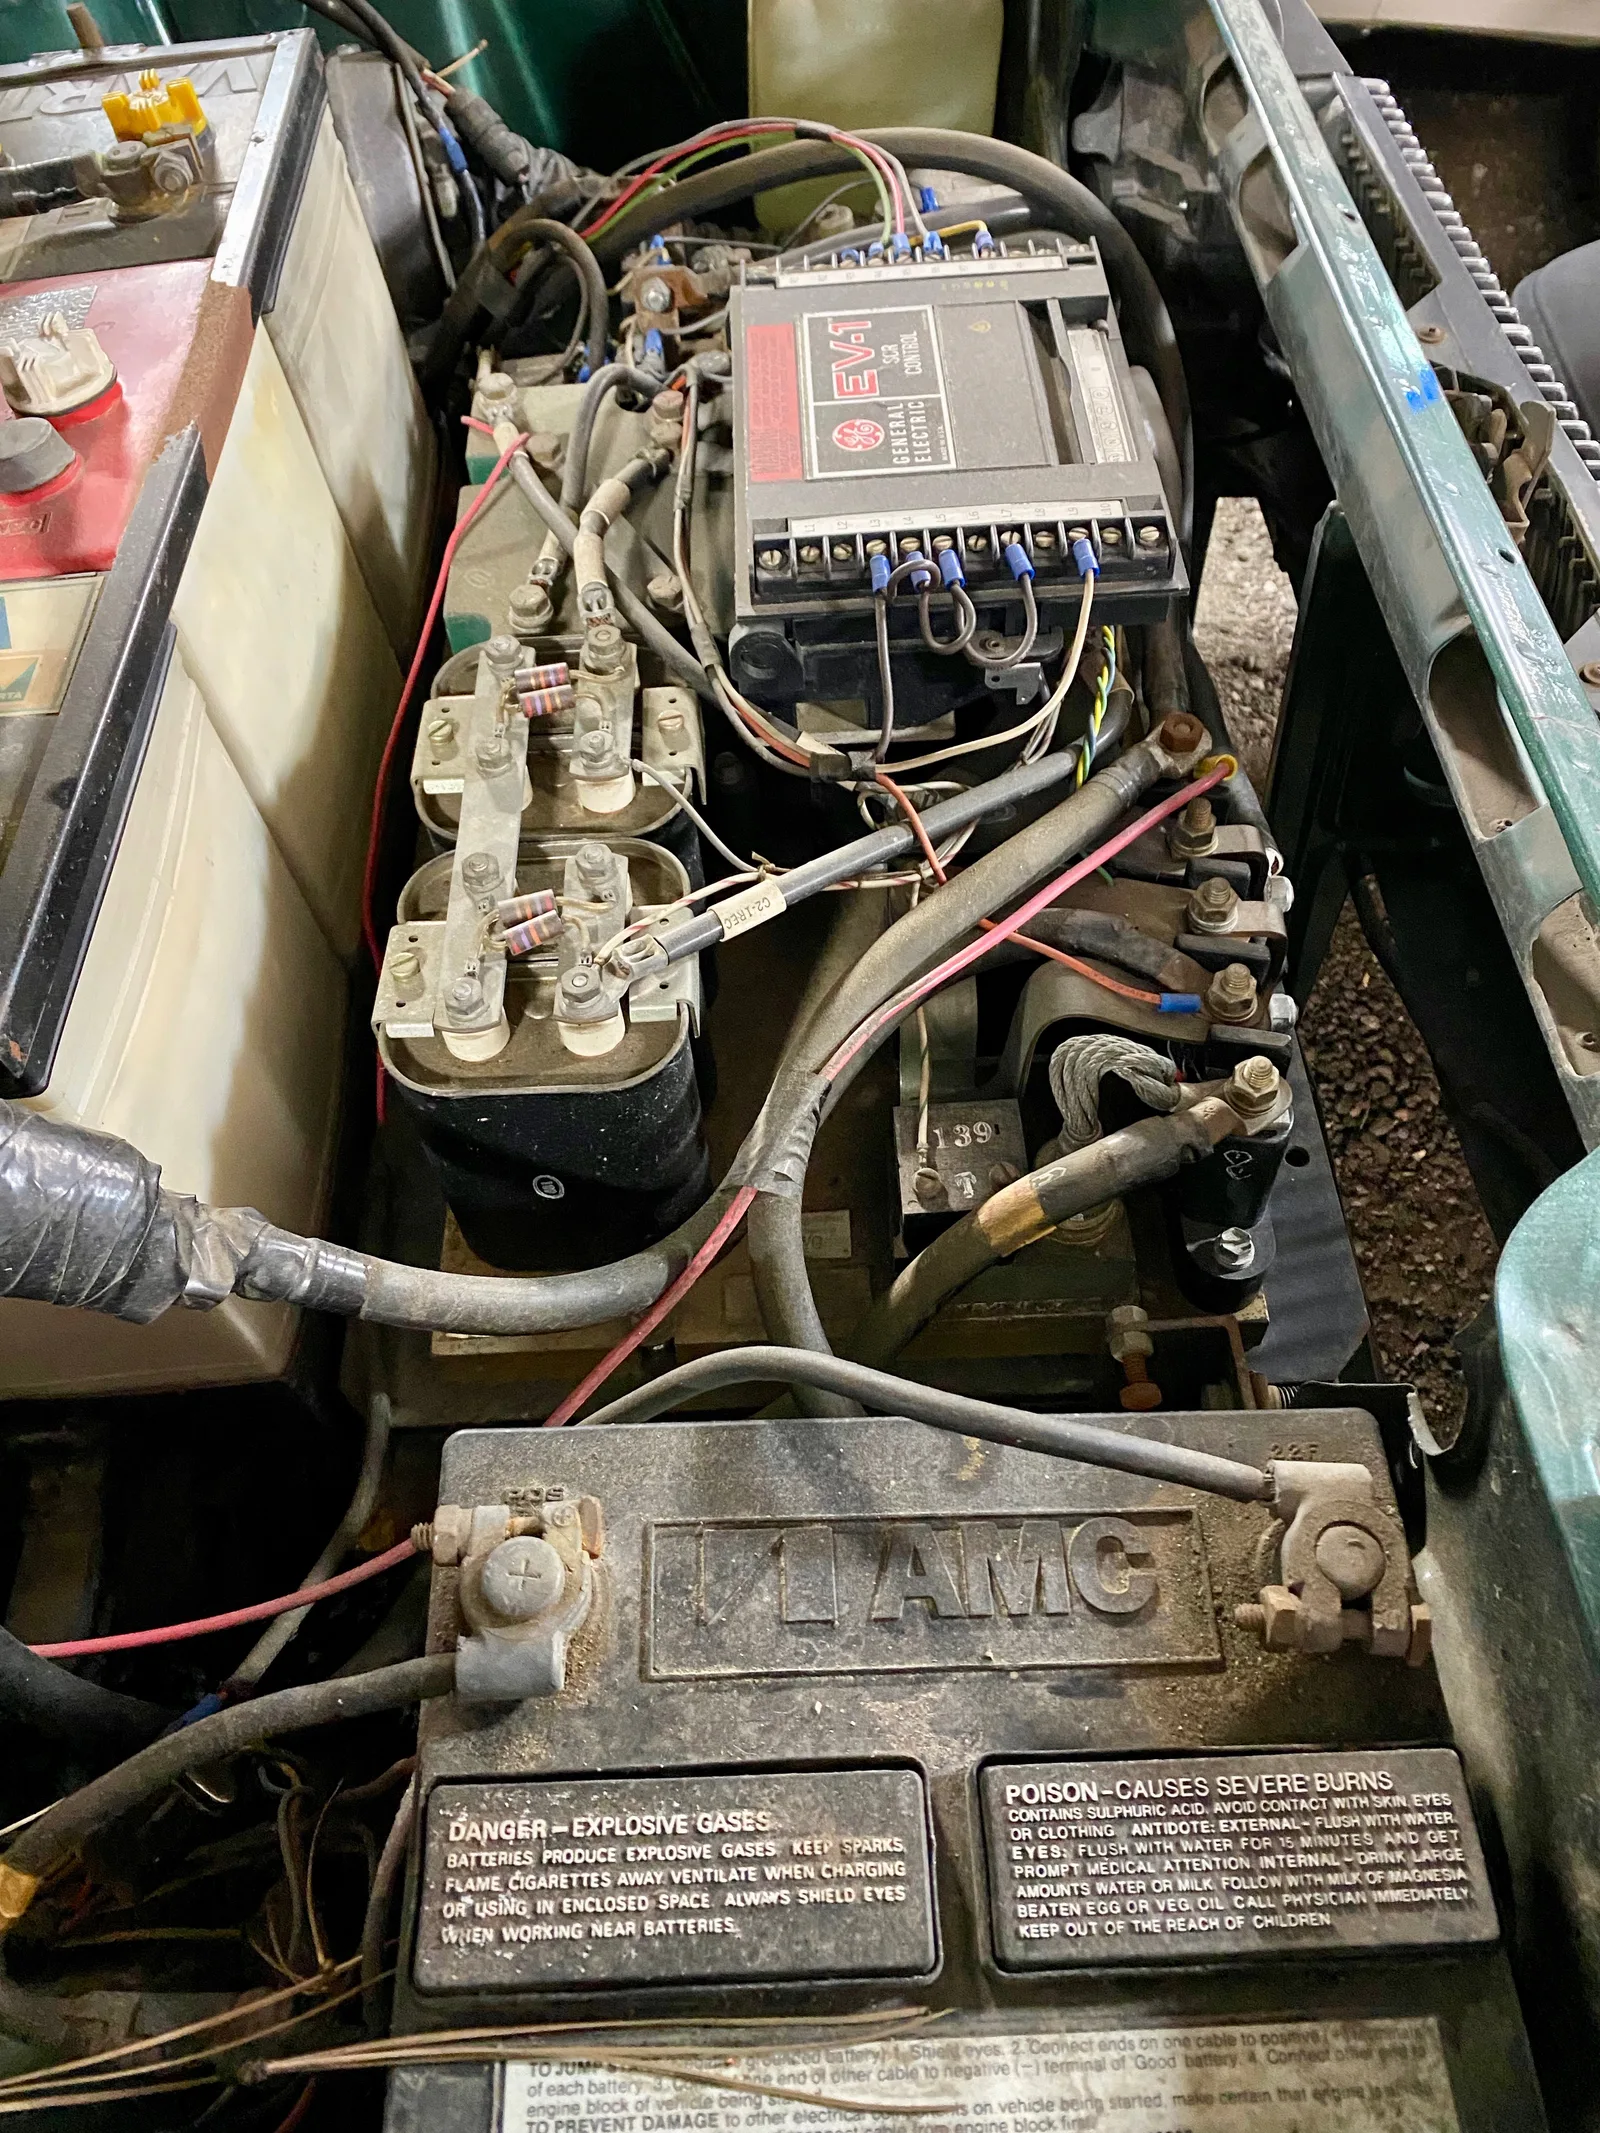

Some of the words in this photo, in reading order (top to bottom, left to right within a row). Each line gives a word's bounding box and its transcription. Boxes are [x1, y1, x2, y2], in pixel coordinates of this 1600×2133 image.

[881, 343, 900, 364] SCR
[901, 330, 922, 375] CONTROL
[887, 403, 910, 465] GENERAL
[908, 401, 932, 463] ELECTRIC
[804, 523, 815, 532] L1
[836, 520, 848, 530] L2
[870, 518, 881, 528] L3
[902, 516, 914, 525] L4
[936, 513, 947, 523] L5
[968, 510, 980, 520] L6
[1000, 508, 1012, 518] L7
[1034, 508, 1046, 517] L8
[1068, 506, 1078, 516] L9
[1100, 502, 1111, 516] L10
[725, 895, 771, 931] C2-1REC
[932, 1121, 993, 1149] 139
[871, 1516, 1160, 1622] AMC
[1217, 1774, 1308, 1795] SEVERE
[1315, 1771, 1394, 1792] BURNS
[1008, 1807, 1082, 1822] CONTAINS
[1087, 1804, 1166, 1819] SULPHURIC
[1214, 1800, 1256, 1814] AVOID
[1262, 1798, 1327, 1812] CONTACT
[1335, 1796, 1370, 1809] WITH
[1415, 1793, 1451, 1806] EYES
[696, 1811, 771, 1834] GASES
[1011, 1827, 1032, 1841] OR
[1132, 1820, 1215, 1836] ANTIDOTE:
[1315, 1814, 1360, 1829] FLUSH
[1365, 1814, 1400, 1827] WITH
[447, 1851, 533, 1868] BATTERIES
[542, 1848, 616, 1864] PRODUCE
[626, 1845, 711, 1861] EXPLOSIVE
[792, 1840, 833, 1855] KEEP
[1012, 1845, 1067, 1860] EYES:
[1079, 1843, 1128, 1857] FLUSH
[1135, 1841, 1172, 1854] WITH
[1181, 1839, 1233, 1852] WATER
[1241, 1838, 1272, 1850] FOR
[1279, 1837, 1293, 1848] 15
[1301, 1832, 1373, 1847] MINUTES
[1384, 1832, 1418, 1845] AND
[1428, 1830, 1461, 1844] GET
[509, 1873, 611, 1890] CIGARETTES
[671, 1867, 757, 1884] VENTILATE
[764, 1865, 814, 1880] WHEN
[821, 1861, 906, 1878] CHARGING
[1014, 1863, 1079, 1878] PROMPT
[1088, 1859, 1155, 1876] MEDICAL
[1260, 1853, 1339, 1869] INTERNAL
[1358, 1852, 1406, 1865] DRINK
[1412, 1848, 1465, 1862] LARGE
[1017, 1881, 1090, 1898] AMOUNTS
[1096, 1880, 1145, 1894] WATER
[1151, 1880, 1172, 1893] OR
[1221, 1874, 1281, 1890] FOLLOW
[1288, 1873, 1323, 1887] WITH
[1329, 1872, 1360, 1885] MILK
[1365, 1871, 1384, 1884] OF
[1388, 1867, 1467, 1882] MAGNESIA
[442, 1902, 466, 1918] OR
[537, 1900, 554, 1914] IN
[562, 1896, 649, 1913] ENCLOSED
[725, 1890, 790, 1907] ALWAYS
[799, 1888, 855, 1904] SHIELD
[864, 1886, 906, 1902] EYES
[1017, 1903, 1080, 1918] BEATEN
[1086, 1901, 1120, 1915] EGG
[1127, 1900, 1148, 1914] OR
[1234, 1895, 1275, 1909] CALL
[1285, 1891, 1367, 1906] PHYSICIAN
[441, 1928, 494, 1944] WHEN
[503, 1924, 582, 1942] WORKING
[591, 1921, 635, 1937] NEAR
[1019, 1923, 1059, 1939] KEEP
[1065, 1922, 1097, 1936] OUT
[1105, 1921, 1124, 1935] OF
[1132, 1919, 1161, 1933] THE
[1166, 1917, 1219, 1932] REACH
[1225, 1916, 1244, 1930] OF
[1252, 1912, 1331, 1929] CHILDREN
[529, 2062, 551, 2078] TO
[1098, 2036, 1135, 2051] ends
[1140, 2037, 1158, 2049] on
[1163, 2036, 1190, 2048] one
[1196, 2033, 1237, 2048] cable
[1240, 2033, 1256, 2046] to
[527, 2082, 543, 2098] of
[546, 2079, 584, 2096] each
[777, 2071, 806, 2084] end
[831, 2067, 872, 2082] other
[877, 2065, 918, 2081] cable
[925, 2065, 939, 2079] to
[944, 2059, 1010, 2080] negative
[1045, 2058, 1107, 2073] terminal
[1112, 2055, 1126, 2070] of
[526, 2103, 580, 2119] engine
[586, 2099, 629, 2115] block
[635, 2098, 649, 2113] of
[555, 2117, 636, 2133] PREVENT
[642, 2113, 719, 2131] DAMAGE
[725, 2114, 740, 2127] to
[746, 2111, 787, 2127] other
[973, 2104, 993, 2115] on
[1000, 2099, 1054, 2114] vehicle
[1060, 2097, 1104, 2114] being
[1014, 2117, 1058, 2133] block
